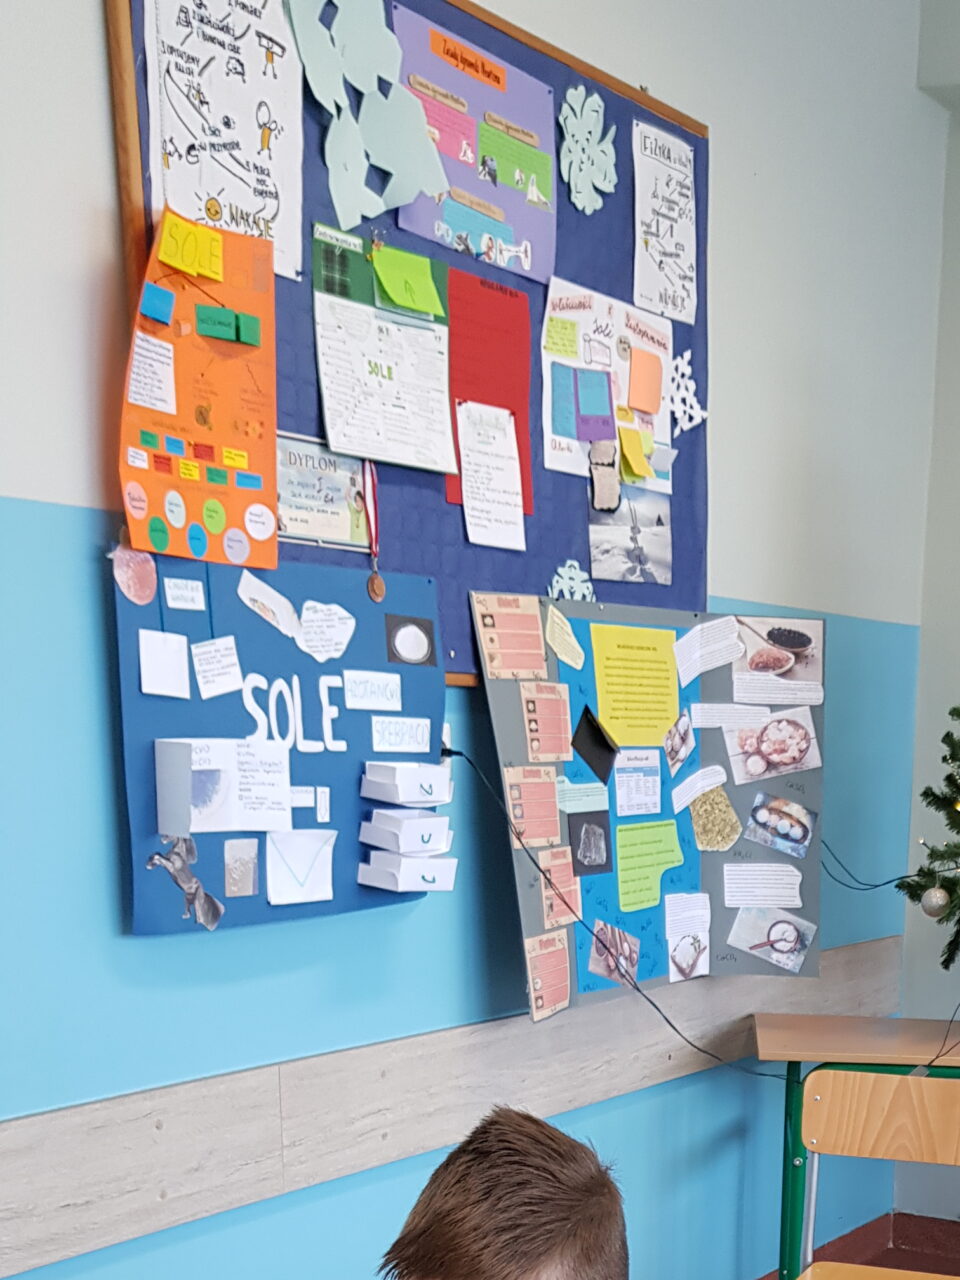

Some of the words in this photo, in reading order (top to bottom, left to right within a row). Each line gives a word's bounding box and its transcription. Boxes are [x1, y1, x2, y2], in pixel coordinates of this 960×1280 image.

[163, 222, 221, 276] SOLE
[367, 359, 394, 381] SOLE
[288, 450, 338, 473] DYPLOM
[242, 672, 348, 753] SOLE
